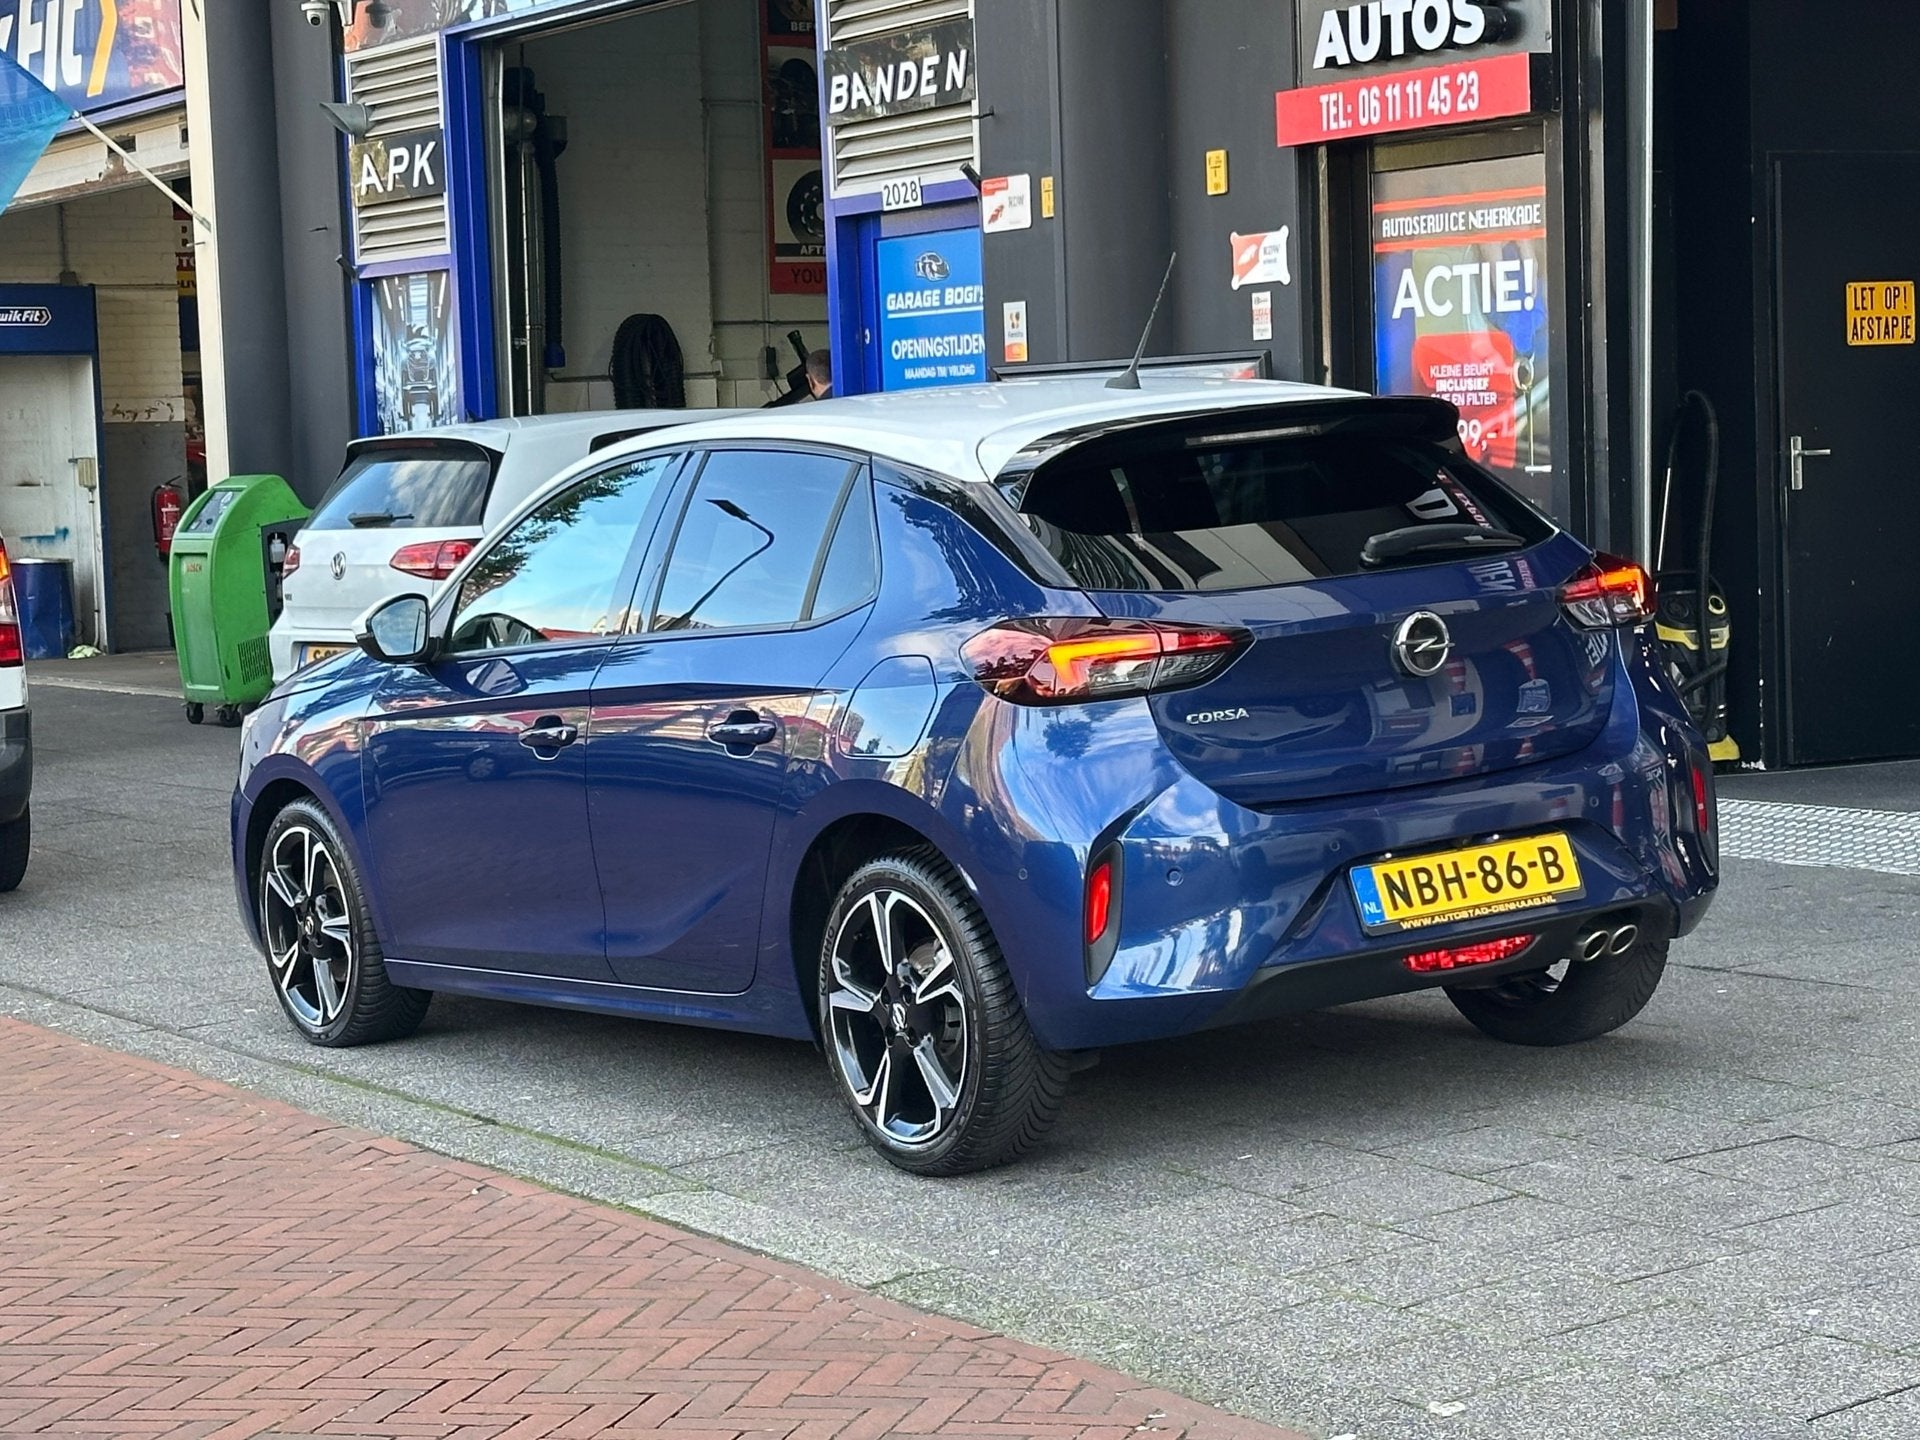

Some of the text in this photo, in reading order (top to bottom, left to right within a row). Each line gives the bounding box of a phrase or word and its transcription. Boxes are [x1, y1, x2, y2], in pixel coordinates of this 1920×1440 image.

[0, 0, 84, 92] Fit
[1313, 0, 1486, 69] AUTOS
[829, 49, 968, 114] BANDEN
[1320, 70, 1479, 131] TEL: 06 11 11 45 23
[360, 141, 437, 196] APK
[883, 181, 919, 207] 2028
[1382, 204, 1542, 238] AUTOSERVICE NEHERKADE
[800, 245, 825, 256] AFT
[886, 289, 941, 311] GARAGE
[1392, 258, 1535, 320] ACTIE!
[1853, 286, 1908, 311] LET OP!
[1851, 315, 1912, 341] AFSTAPJE
[1430, 362, 1495, 379] KLEINE BEURT
[1436, 377, 1490, 392] INCLUSIEF
[1451, 392, 1465, 407] EN
[1466, 391, 1498, 406] FILTER
[1186, 707, 1250, 725] CORSA
[1383, 845, 1565, 911] NBH-86-B
[1364, 902, 1381, 915] NL
